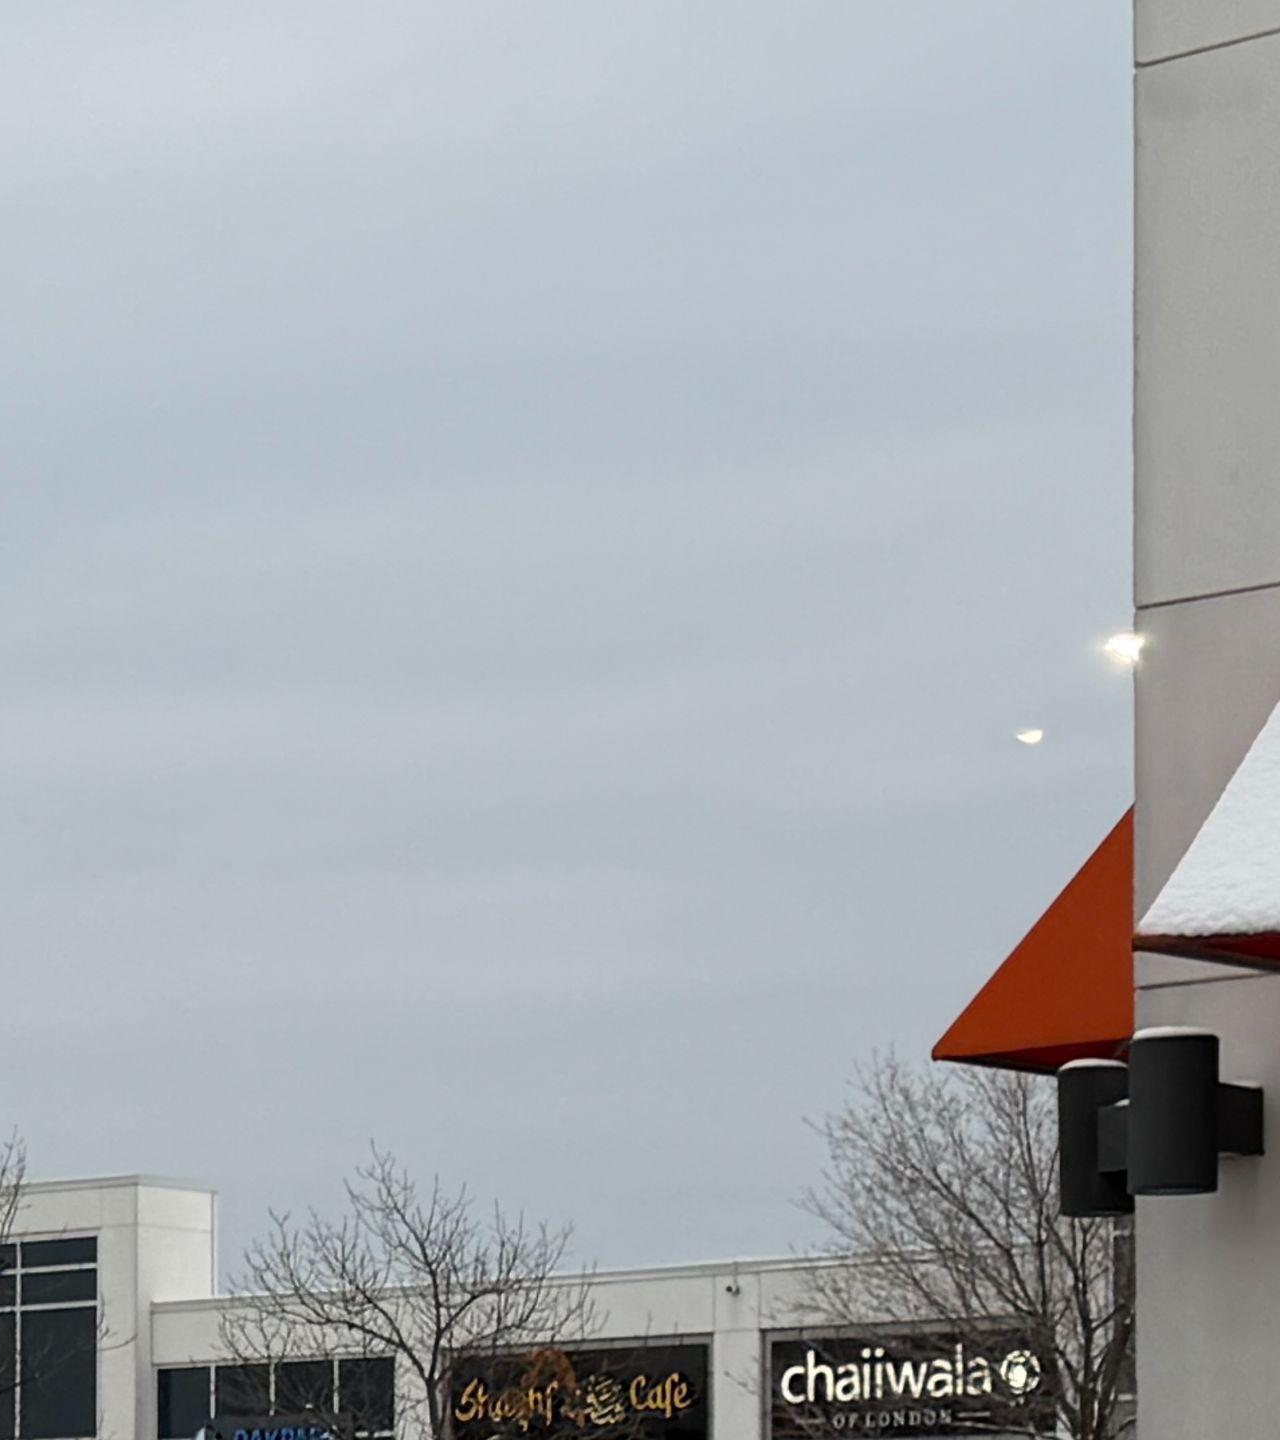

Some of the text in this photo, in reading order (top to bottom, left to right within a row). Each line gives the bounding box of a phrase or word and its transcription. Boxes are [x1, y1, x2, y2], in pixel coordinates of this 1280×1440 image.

[629, 1372, 690, 1418] Cafe
[780, 1342, 993, 1404] chaiiwala
[832, 1408, 953, 1429] OF LONDON
